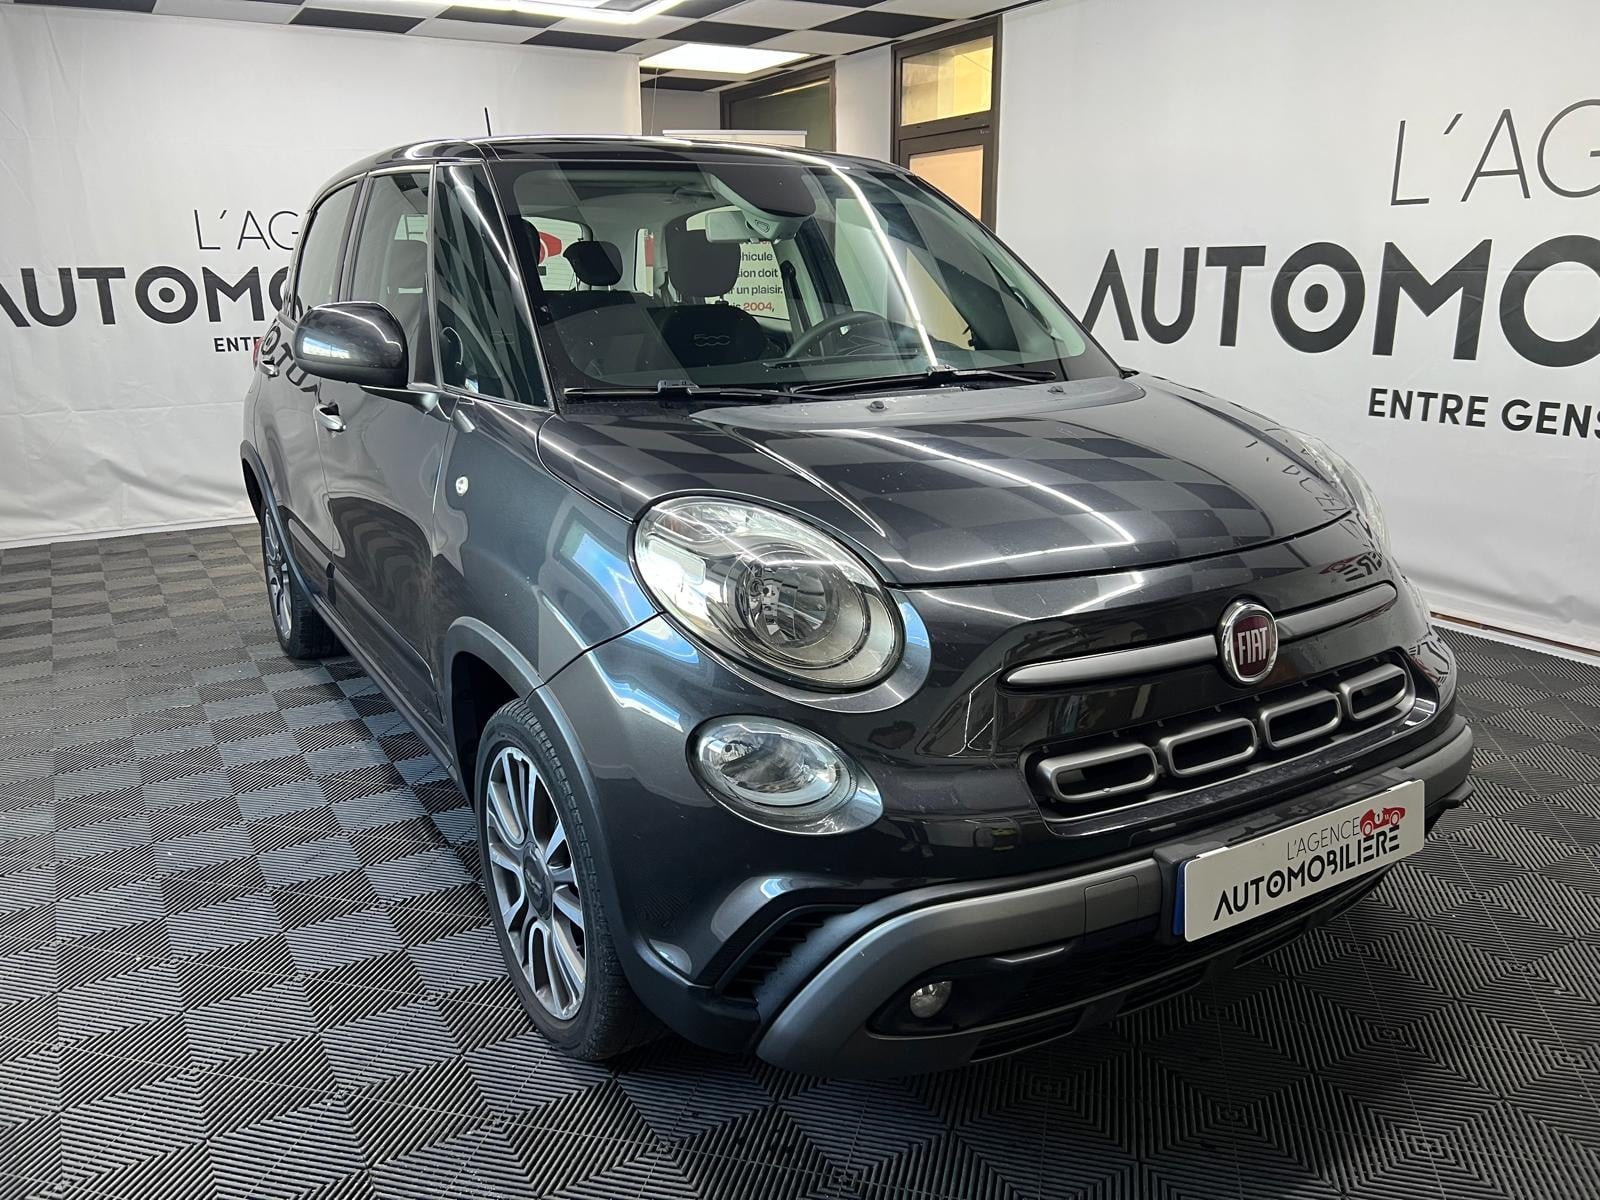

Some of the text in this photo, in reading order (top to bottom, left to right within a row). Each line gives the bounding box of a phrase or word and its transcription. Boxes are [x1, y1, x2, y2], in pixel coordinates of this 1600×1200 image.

[741, 252, 773, 261] hicule
[758, 268, 778, 278] doit
[1368, 388, 1489, 429] ENTRE
[1237, 627, 1268, 665] FIAT
[1287, 816, 1360, 861] L'AGENCE
